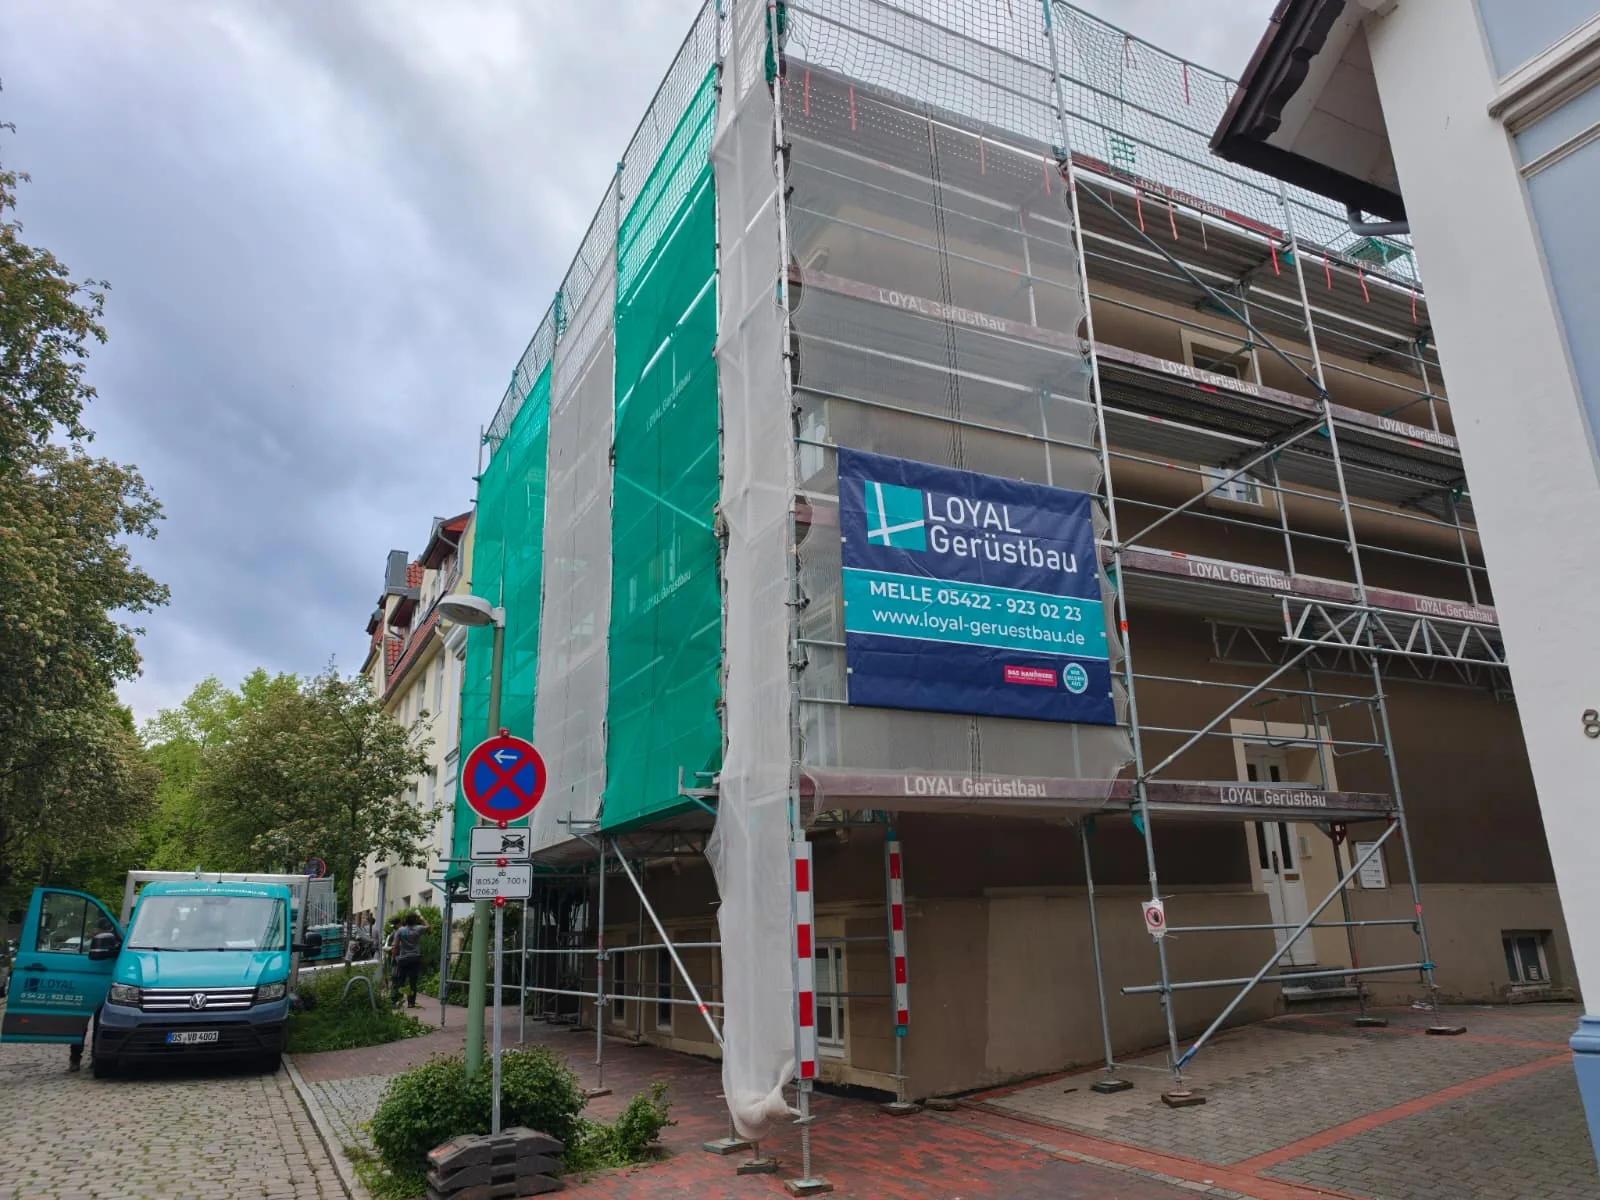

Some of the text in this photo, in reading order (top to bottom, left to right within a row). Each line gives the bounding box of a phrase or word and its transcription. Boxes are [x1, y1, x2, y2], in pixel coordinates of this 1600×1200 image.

[880, 290, 928, 314] LOYAL
[1160, 359, 1199, 381] LOYAL
[1378, 416, 1454, 448] LOYAL Gerüstbau
[926, 492, 1022, 535] LOYAL
[929, 524, 1078, 573] Gerüstbau
[1188, 561, 1292, 591] LOYAL Gerüstbau
[870, 580, 933, 603] MELLE
[937, 589, 992, 611] 05422
[1005, 598, 1036, 616] 923
[1039, 602, 1060, 620] 02
[1063, 605, 1082, 622] 23
[1415, 600, 1493, 623] LOYAL Gerüstbau
[872, 608, 1085, 646] www.loyal-geruestbau.de
[904, 776, 1048, 797] LOYAL Gerüstbau
[1220, 787, 1326, 807] LOYAL Gerüstbau
